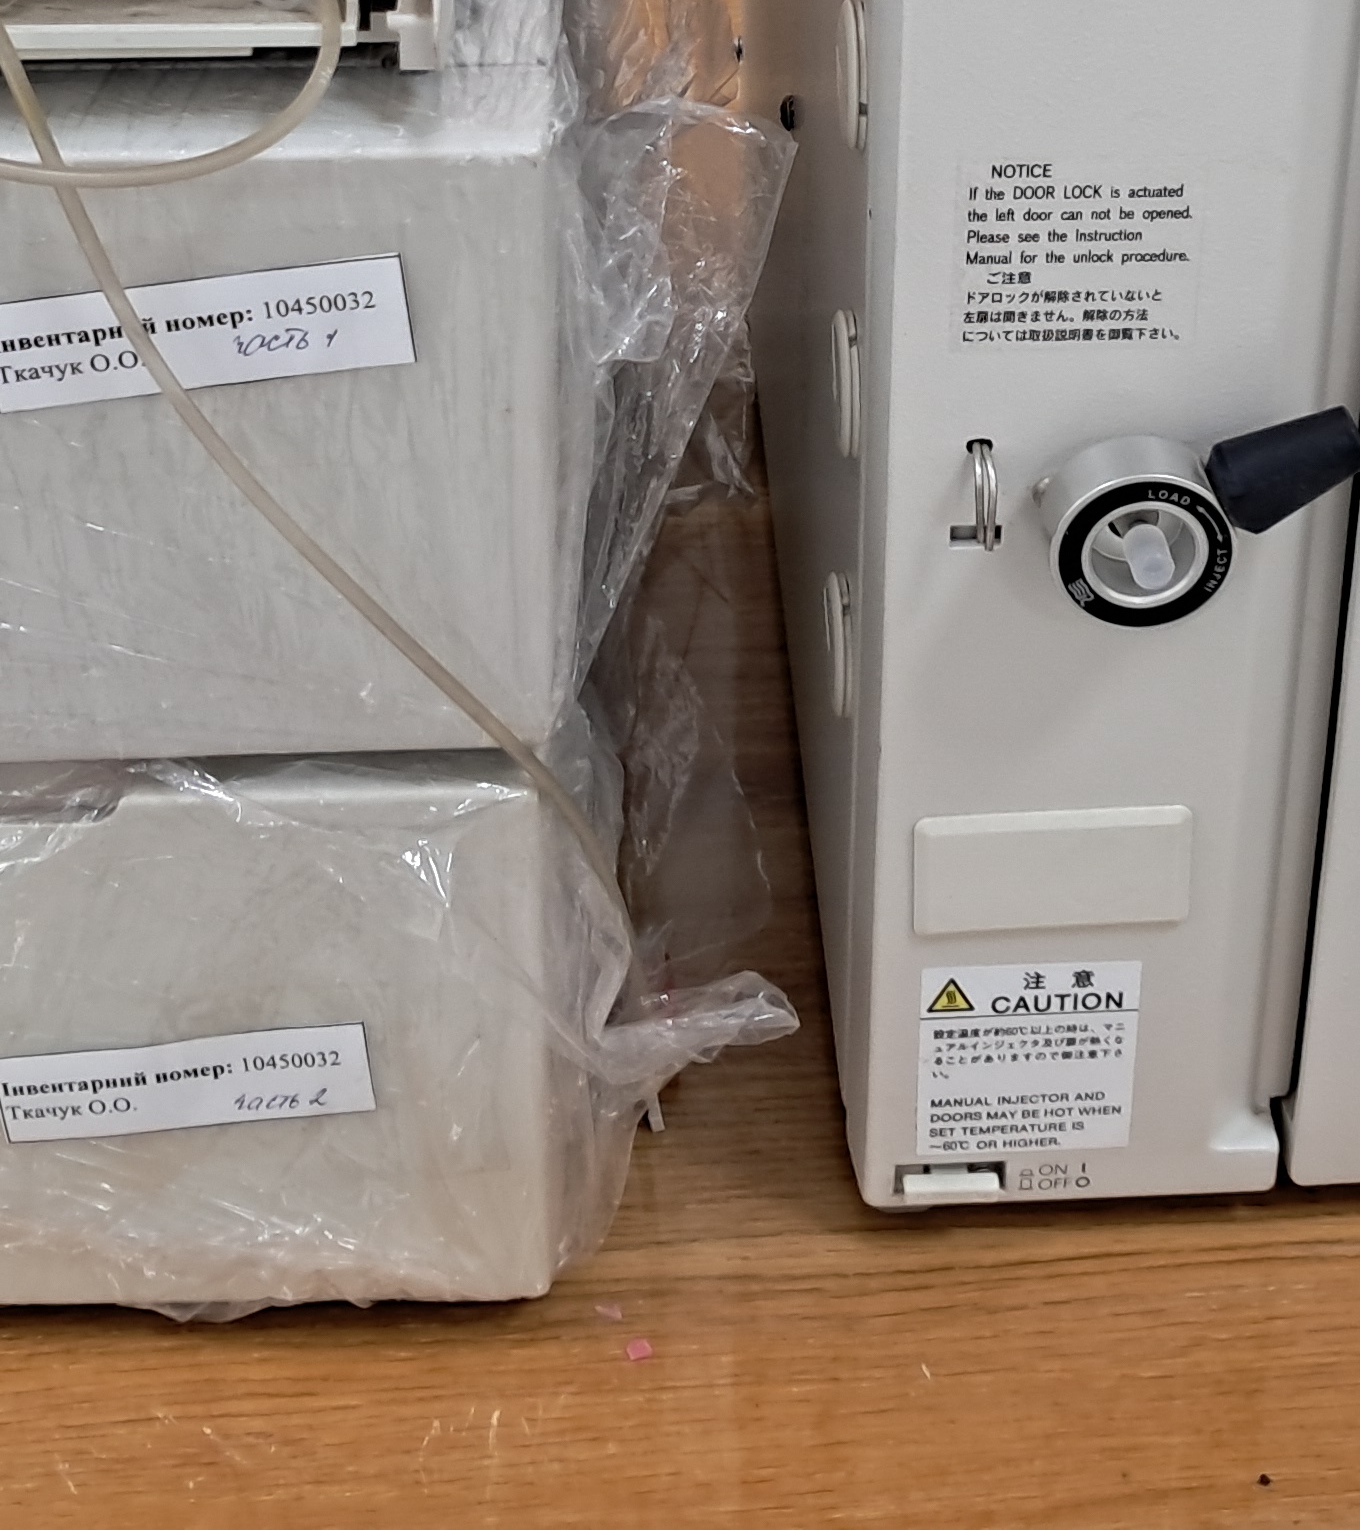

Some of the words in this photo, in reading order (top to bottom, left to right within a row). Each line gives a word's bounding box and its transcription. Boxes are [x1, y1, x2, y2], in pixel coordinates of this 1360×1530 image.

[990, 163, 1053, 179] NOTICE
[969, 187, 978, 201] If
[985, 187, 1005, 201] the
[1012, 185, 1055, 200] DOOR
[1063, 184, 1103, 199] LOCK
[1110, 185, 1121, 199] is
[1128, 183, 1185, 198] actuated
[967, 209, 988, 223] the
[995, 207, 1016, 222] left
[1023, 207, 1054, 222] door
[1060, 210, 1083, 221] can
[1090, 207, 1112, 221] not
[1119, 206, 1135, 220] be
[1142, 205, 1193, 223] opened.
[967, 229, 1011, 244] Please
[1017, 232, 1041, 243] see
[1047, 229, 1068, 243] the
[1075, 228, 1143, 242] Instruction
[966, 250, 1012, 266] Manual
[1020, 250, 1038, 265] for
[1045, 250, 1066, 264] the
[1073, 249, 1114, 264] unlock
[1121, 249, 1190, 266] procedure.
[986, 271, 1032, 285] ご注意
[165, 308, 254, 337] номер:
[263, 290, 377, 321] 10450032
[1147, 489, 1191, 506] LOAD
[1203, 548, 1228, 593] INJECT
[991, 991, 1124, 1014] CAUTION
[0, 1071, 148, 1098] Інвентарний
[154, 1061, 234, 1086] номер:
[241, 1050, 342, 1073] 10450032
[308, 1087, 329, 1107] 2
[930, 1096, 991, 1108] MANUAL
[997, 1092, 1070, 1106] INJECTOR
[1074, 1091, 1106, 1102] AND
[5, 1102, 83, 1121] Ткачук
[88, 1097, 137, 1116] О.О.
[930, 1111, 983, 1123] DOORS
[986, 1109, 1018, 1120] MAY
[1021, 1108, 1040, 1119] BE
[1044, 1106, 1074, 1117] HOT
[1078, 1105, 1122, 1116] WHEN
[929, 1126, 955, 1138] SET
[961, 1121, 1067, 1136] TEMPERATURE
[1072, 1121, 1085, 1131] IS
[976, 1139, 998, 1150] OR
[1002, 1137, 1061, 1149] HIGHER.
[1039, 1164, 1068, 1176] ON
